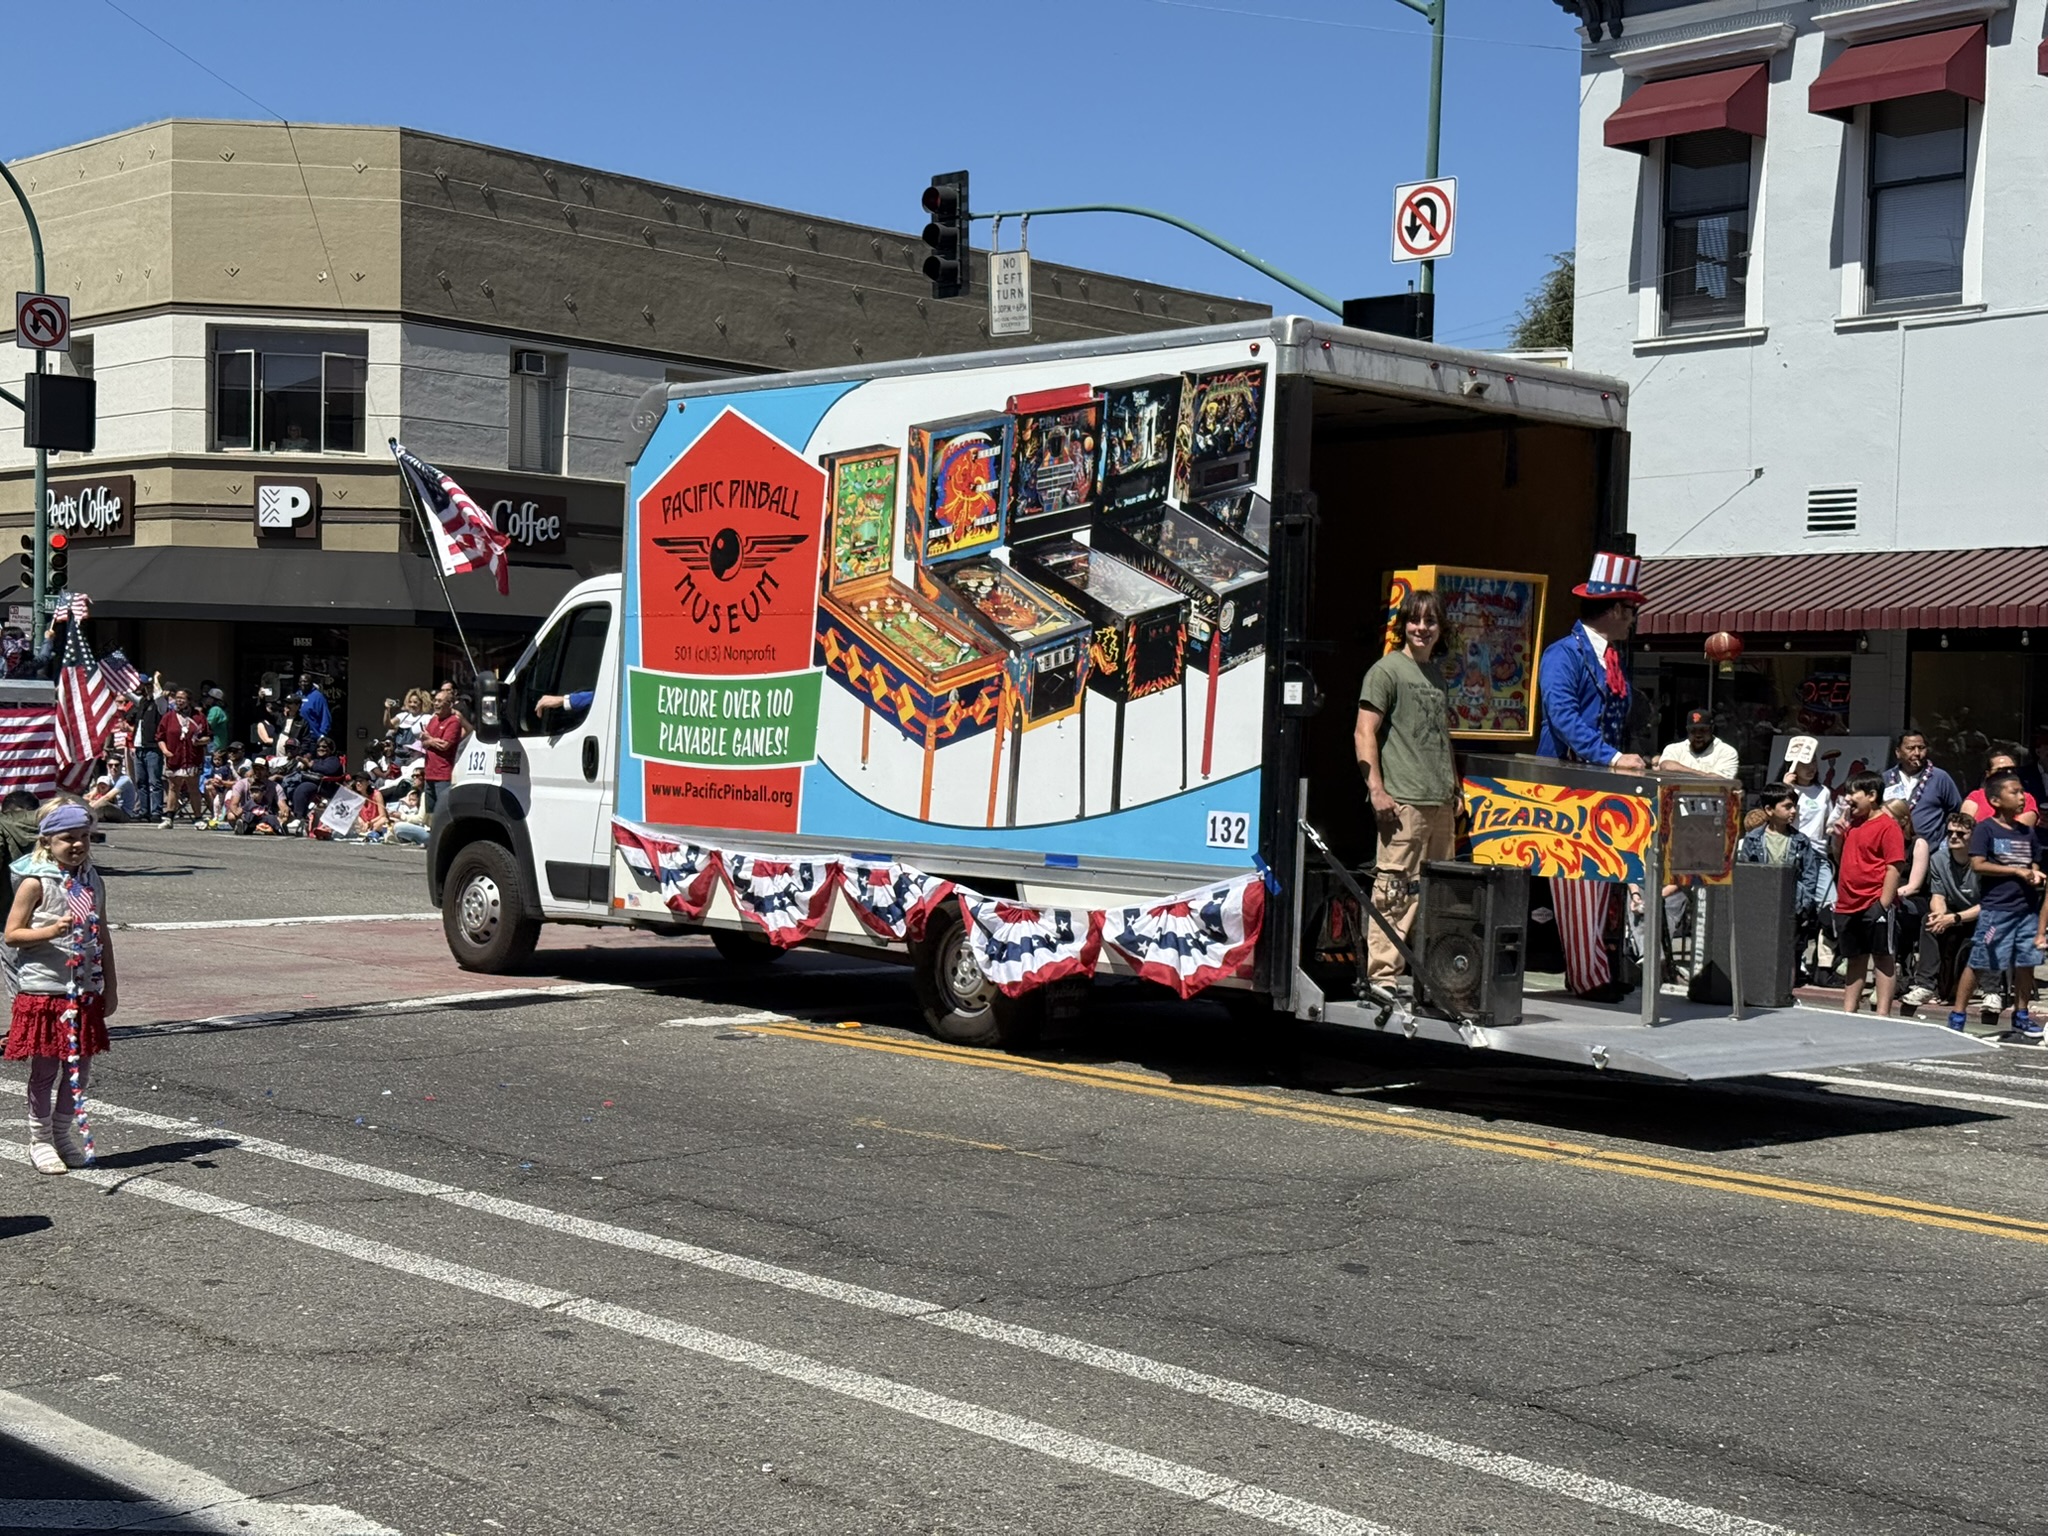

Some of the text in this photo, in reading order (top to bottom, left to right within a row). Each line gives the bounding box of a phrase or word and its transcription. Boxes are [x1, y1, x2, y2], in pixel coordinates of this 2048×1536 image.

[1003, 258, 1016, 269] NO
[997, 273, 1023, 285] LEFT
[997, 288, 1024, 300] TURN
[79, 486, 121, 531] Coffee
[662, 479, 800, 524] PACIFIC PINBALL
[492, 500, 560, 546] Coffee
[674, 569, 780, 634] MUSEUM
[674, 645, 776, 664] 501 (c)(3) Nonprofit
[658, 685, 794, 719] EXPLORE OVER 100
[659, 722, 790, 758] PLAYABLE GAMES!
[468, 751, 486, 771] 132
[652, 782, 793, 808] www.PacificPinball.org
[1210, 815, 1246, 845] 132
